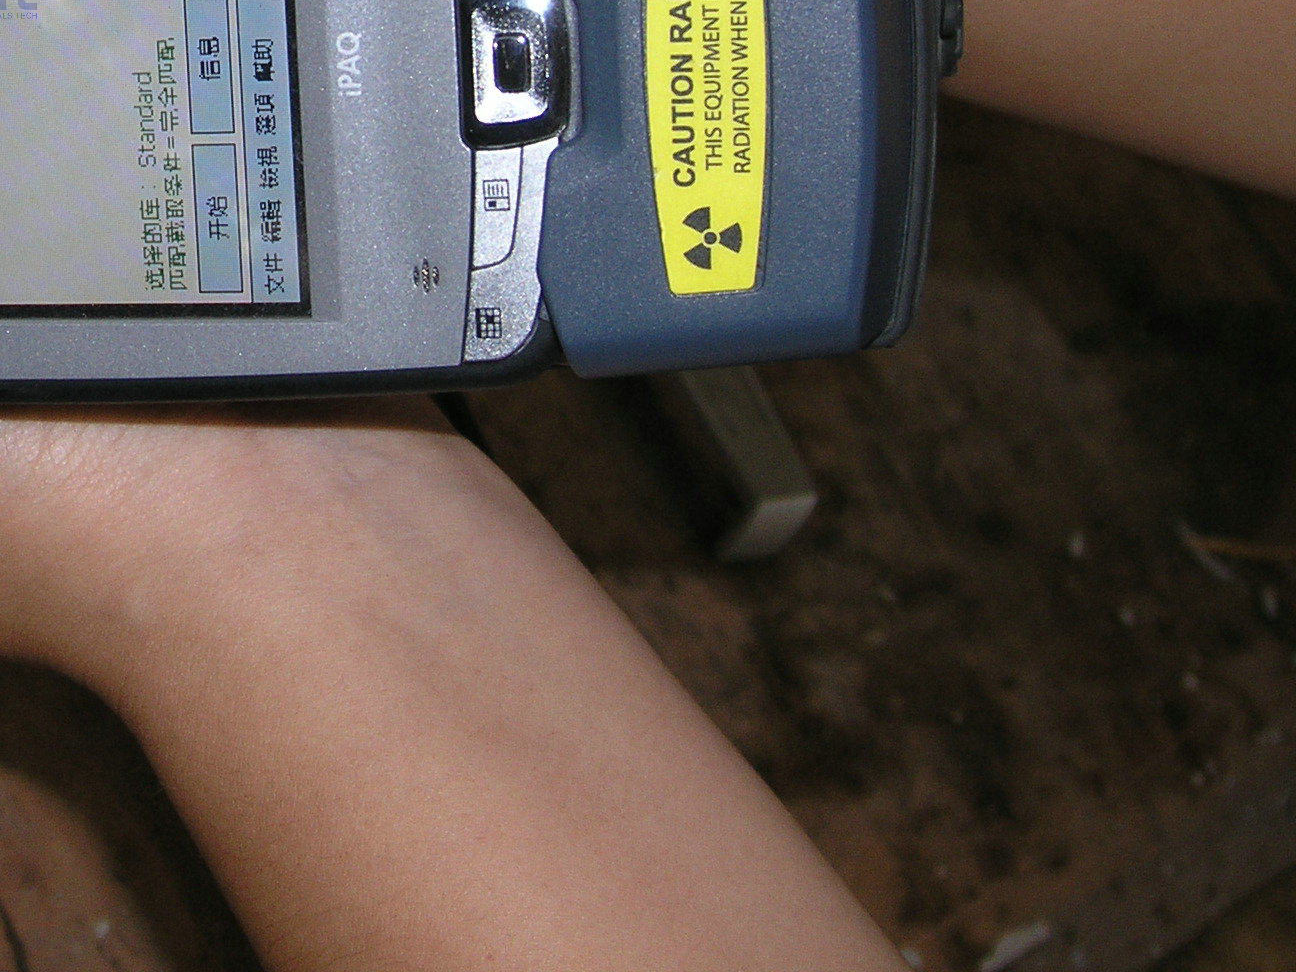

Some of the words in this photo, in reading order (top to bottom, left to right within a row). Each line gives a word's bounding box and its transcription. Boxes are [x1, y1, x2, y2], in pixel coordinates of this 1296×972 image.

[197, 36, 221, 82] 信息
[701, 5, 723, 122] EQUIPMENT
[730, 0, 749, 63] WHEN
[336, 32, 363, 97] iPAQ
[131, 71, 157, 167] Standard
[670, 54, 696, 188] CAUTION
[704, 126, 724, 171] THIS
[732, 66, 751, 174] RADIATION
[206, 196, 231, 241] 开始
[263, 252, 285, 295] 文件
